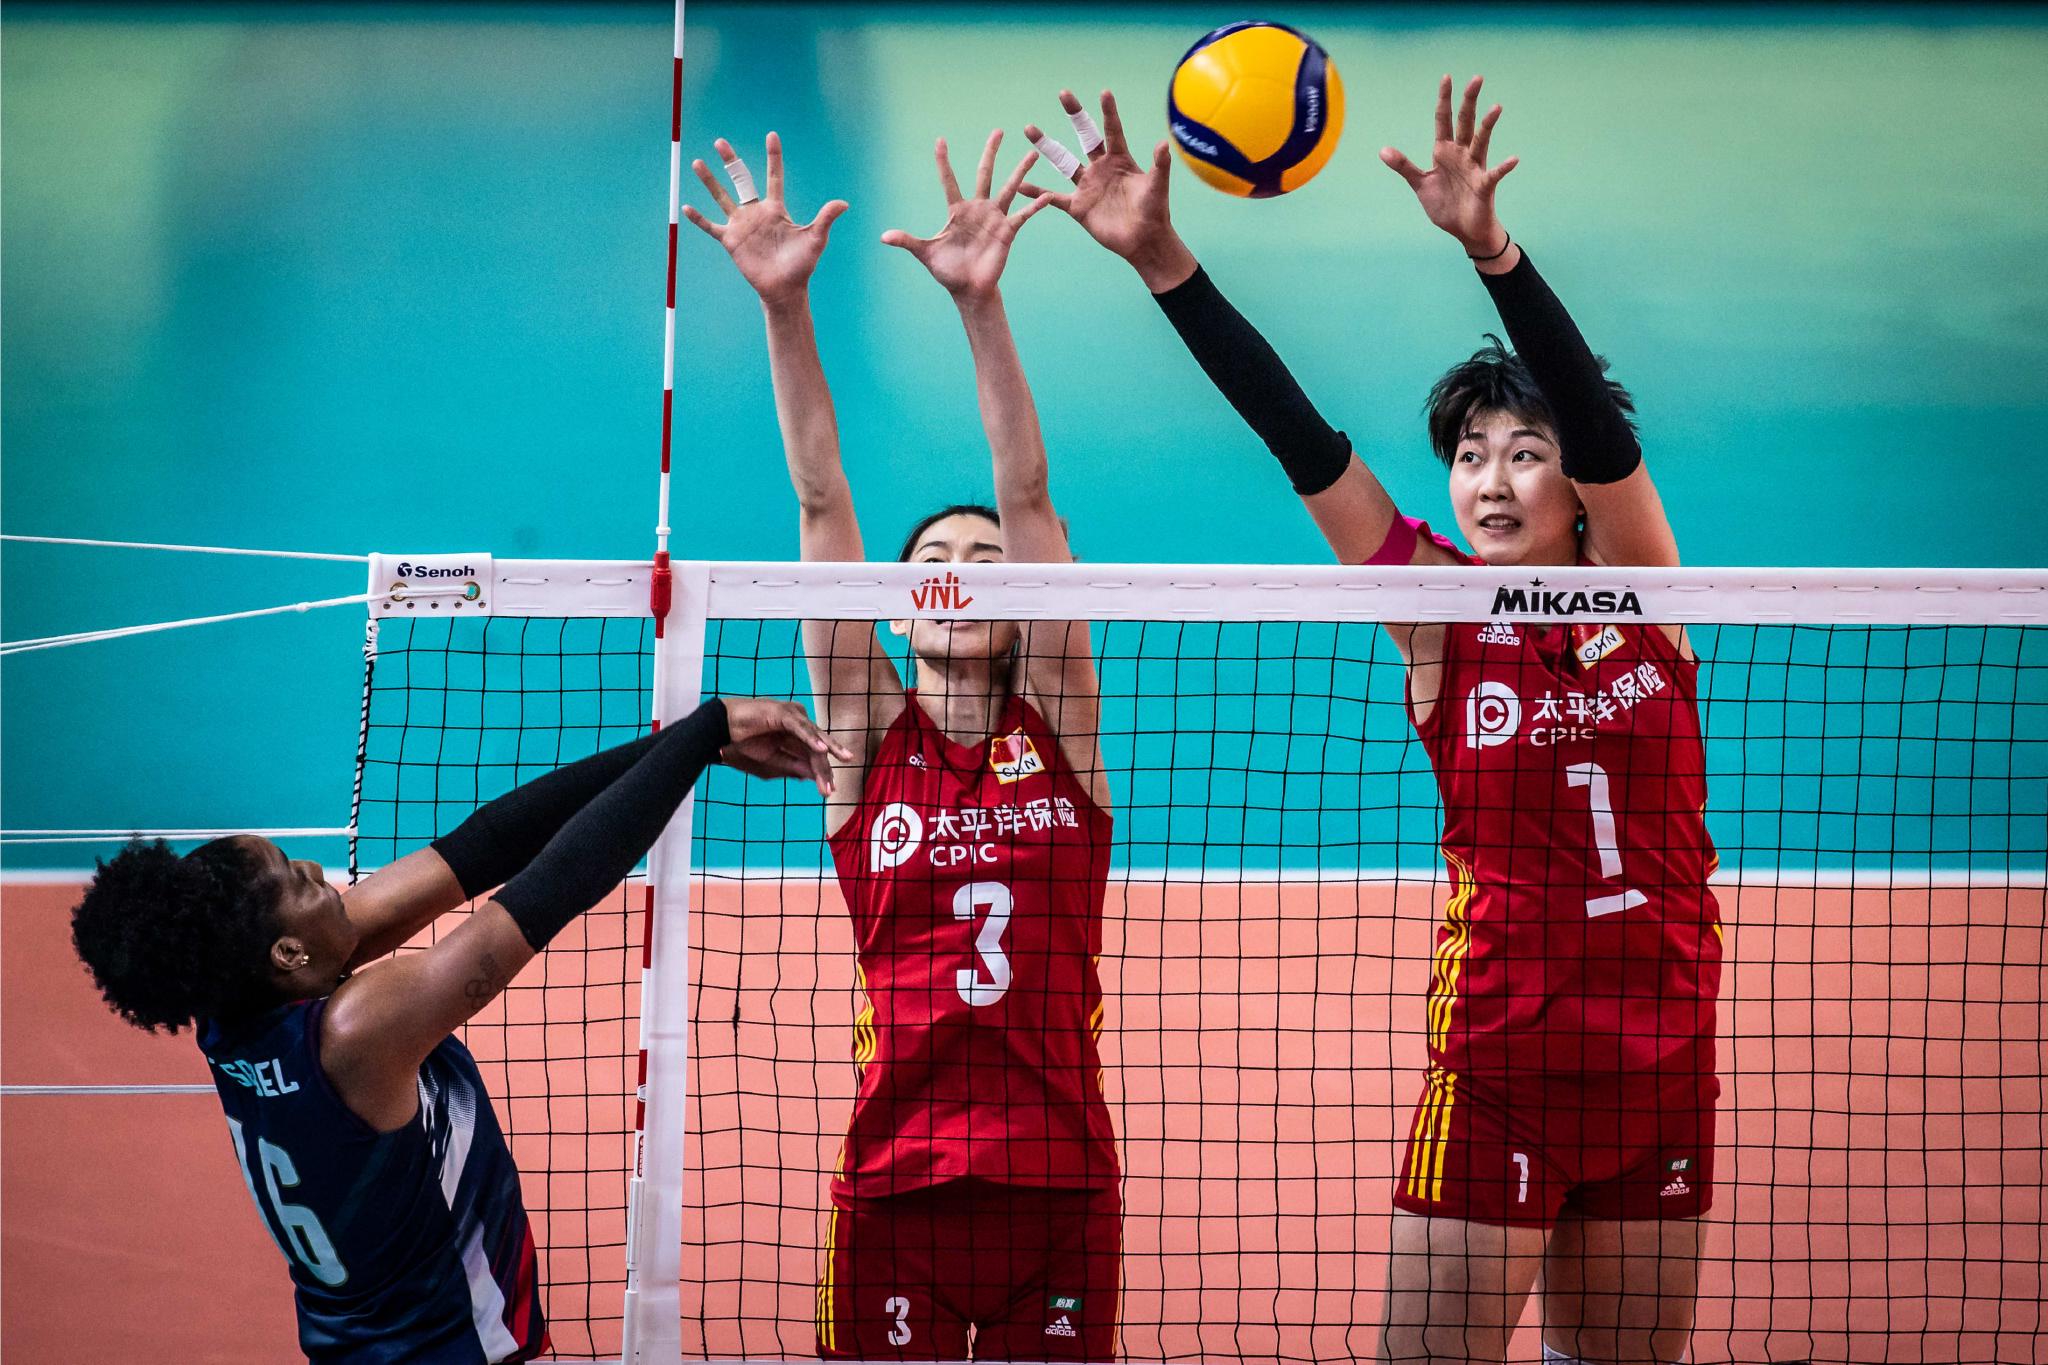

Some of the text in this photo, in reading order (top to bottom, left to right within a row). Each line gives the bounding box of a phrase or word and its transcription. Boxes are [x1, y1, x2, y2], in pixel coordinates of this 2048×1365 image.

[414, 565, 475, 578] Senoh
[911, 572, 974, 609] VNL
[1491, 577, 1643, 616] MIKASA
[1477, 630, 1520, 646] adidas
[1584, 632, 1617, 660] CHN
[1529, 726, 1596, 747] CPIC
[928, 796, 1079, 841] 太平洋保险
[929, 842, 998, 867] CPIC
[1565, 762, 1649, 918] 1
[952, 881, 1014, 1007] 3
[1512, 1152, 1530, 1203] 1
[885, 1296, 912, 1347] 3
[1045, 1326, 1076, 1337] adidas
